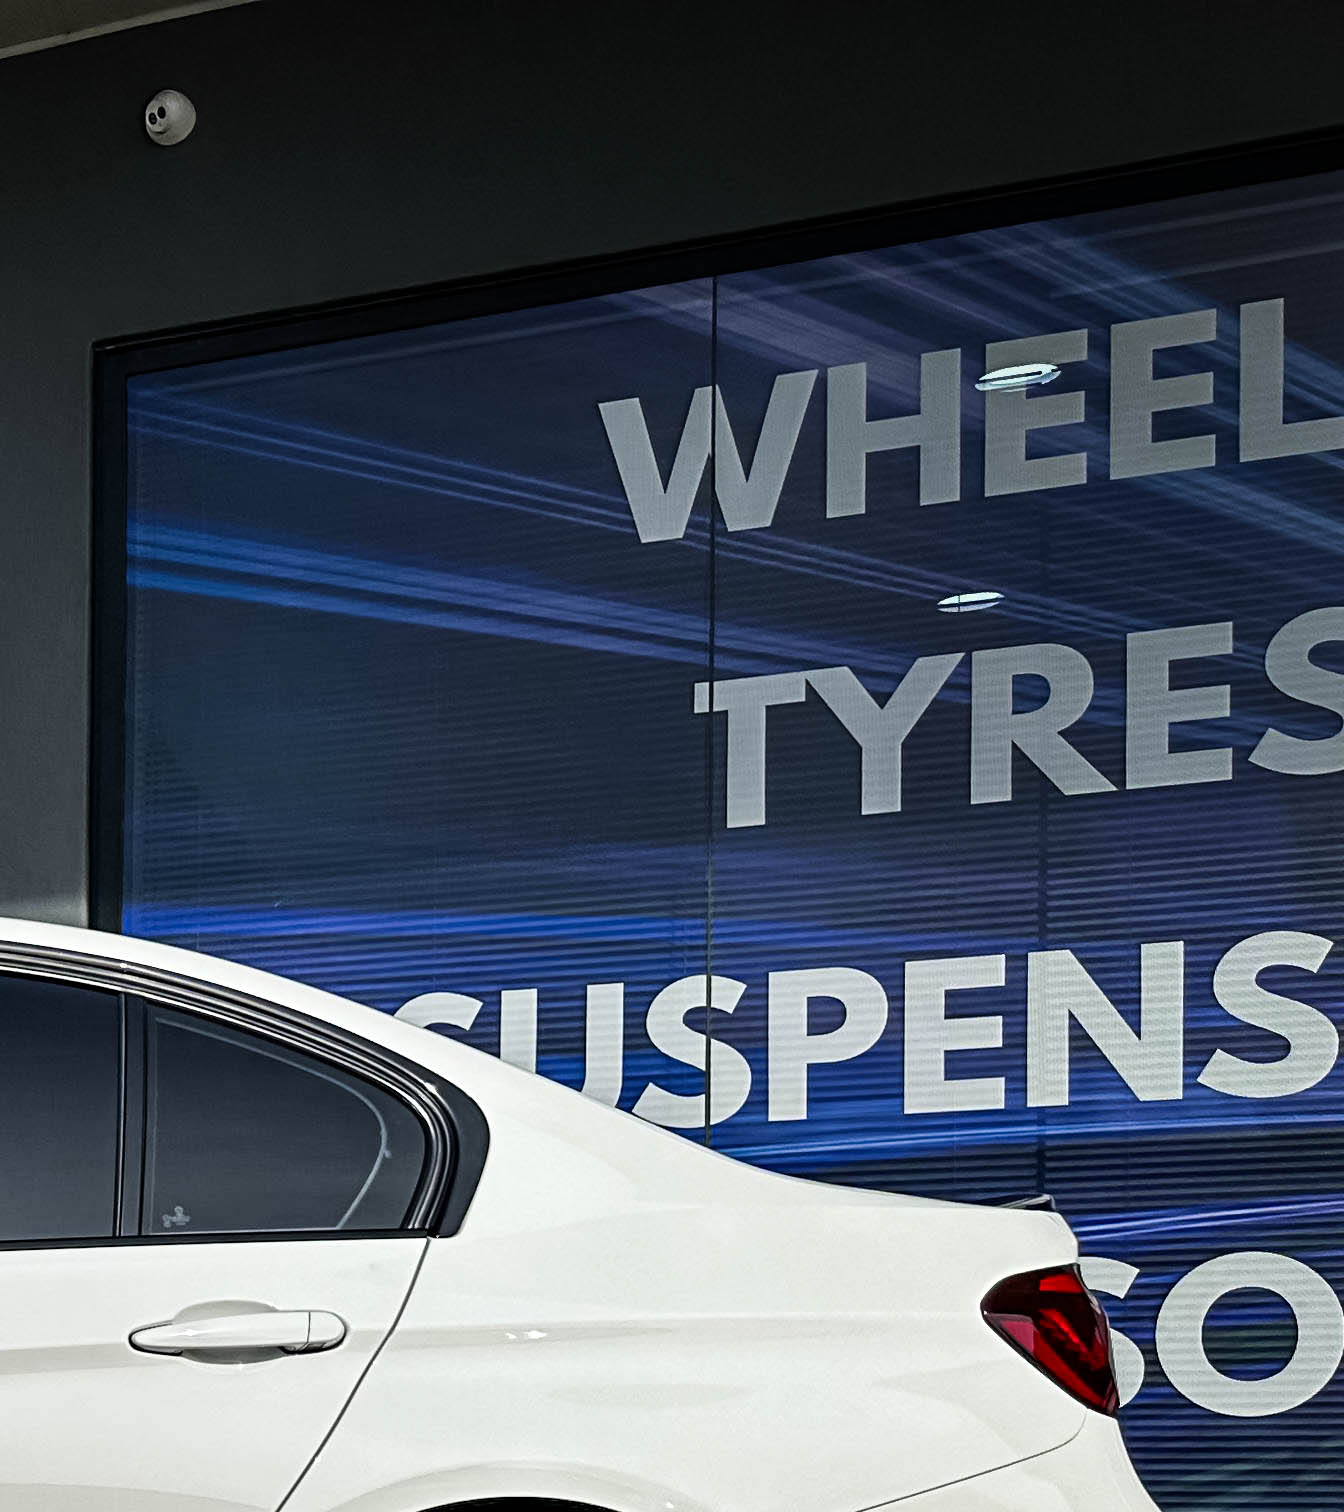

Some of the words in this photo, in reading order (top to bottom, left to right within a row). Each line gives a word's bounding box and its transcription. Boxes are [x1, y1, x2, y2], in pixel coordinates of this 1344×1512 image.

[598, 297, 1344, 543] WHEEL
[694, 607, 1344, 829] TYRES
[393, 929, 1340, 1128] USPENS
